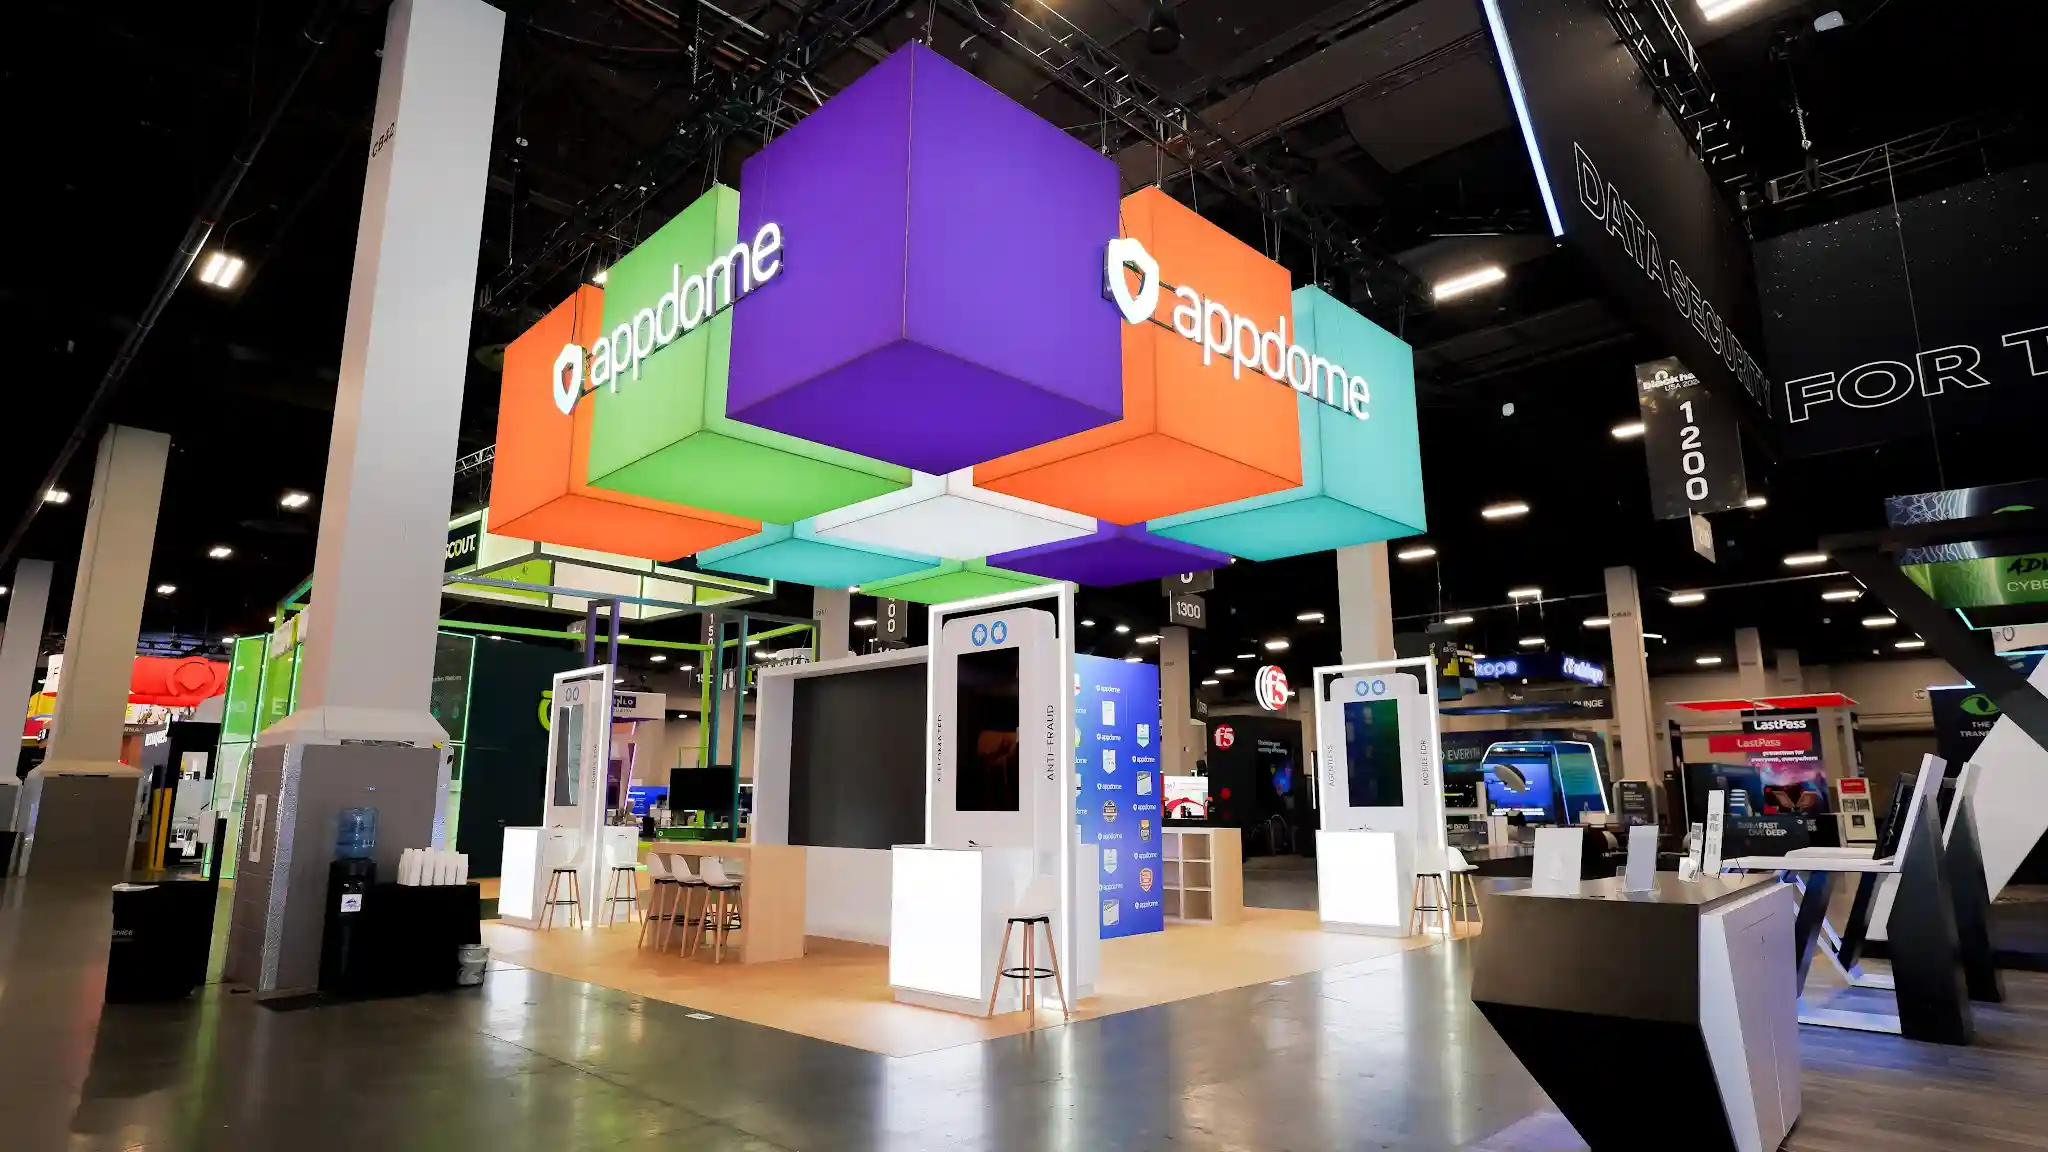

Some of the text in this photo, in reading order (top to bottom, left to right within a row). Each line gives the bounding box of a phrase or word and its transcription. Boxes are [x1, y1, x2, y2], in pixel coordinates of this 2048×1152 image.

[1573, 140, 1772, 419] DATA SECURITY
[590, 222, 782, 394] appdome
[1173, 285, 1371, 421] appdome
[1664, 382, 1682, 392] USA
[1785, 344, 1991, 424] FOR
[1679, 400, 1709, 501] 1200
[1176, 601, 1201, 619] 1300
[1046, 704, 1055, 781] ANTI-FRAUD
[1736, 738, 1782, 748] LastPass
[1753, 719, 1807, 731] LastPass
[1758, 822, 1778, 830] FAST
[1765, 828, 1787, 836] DEEP
